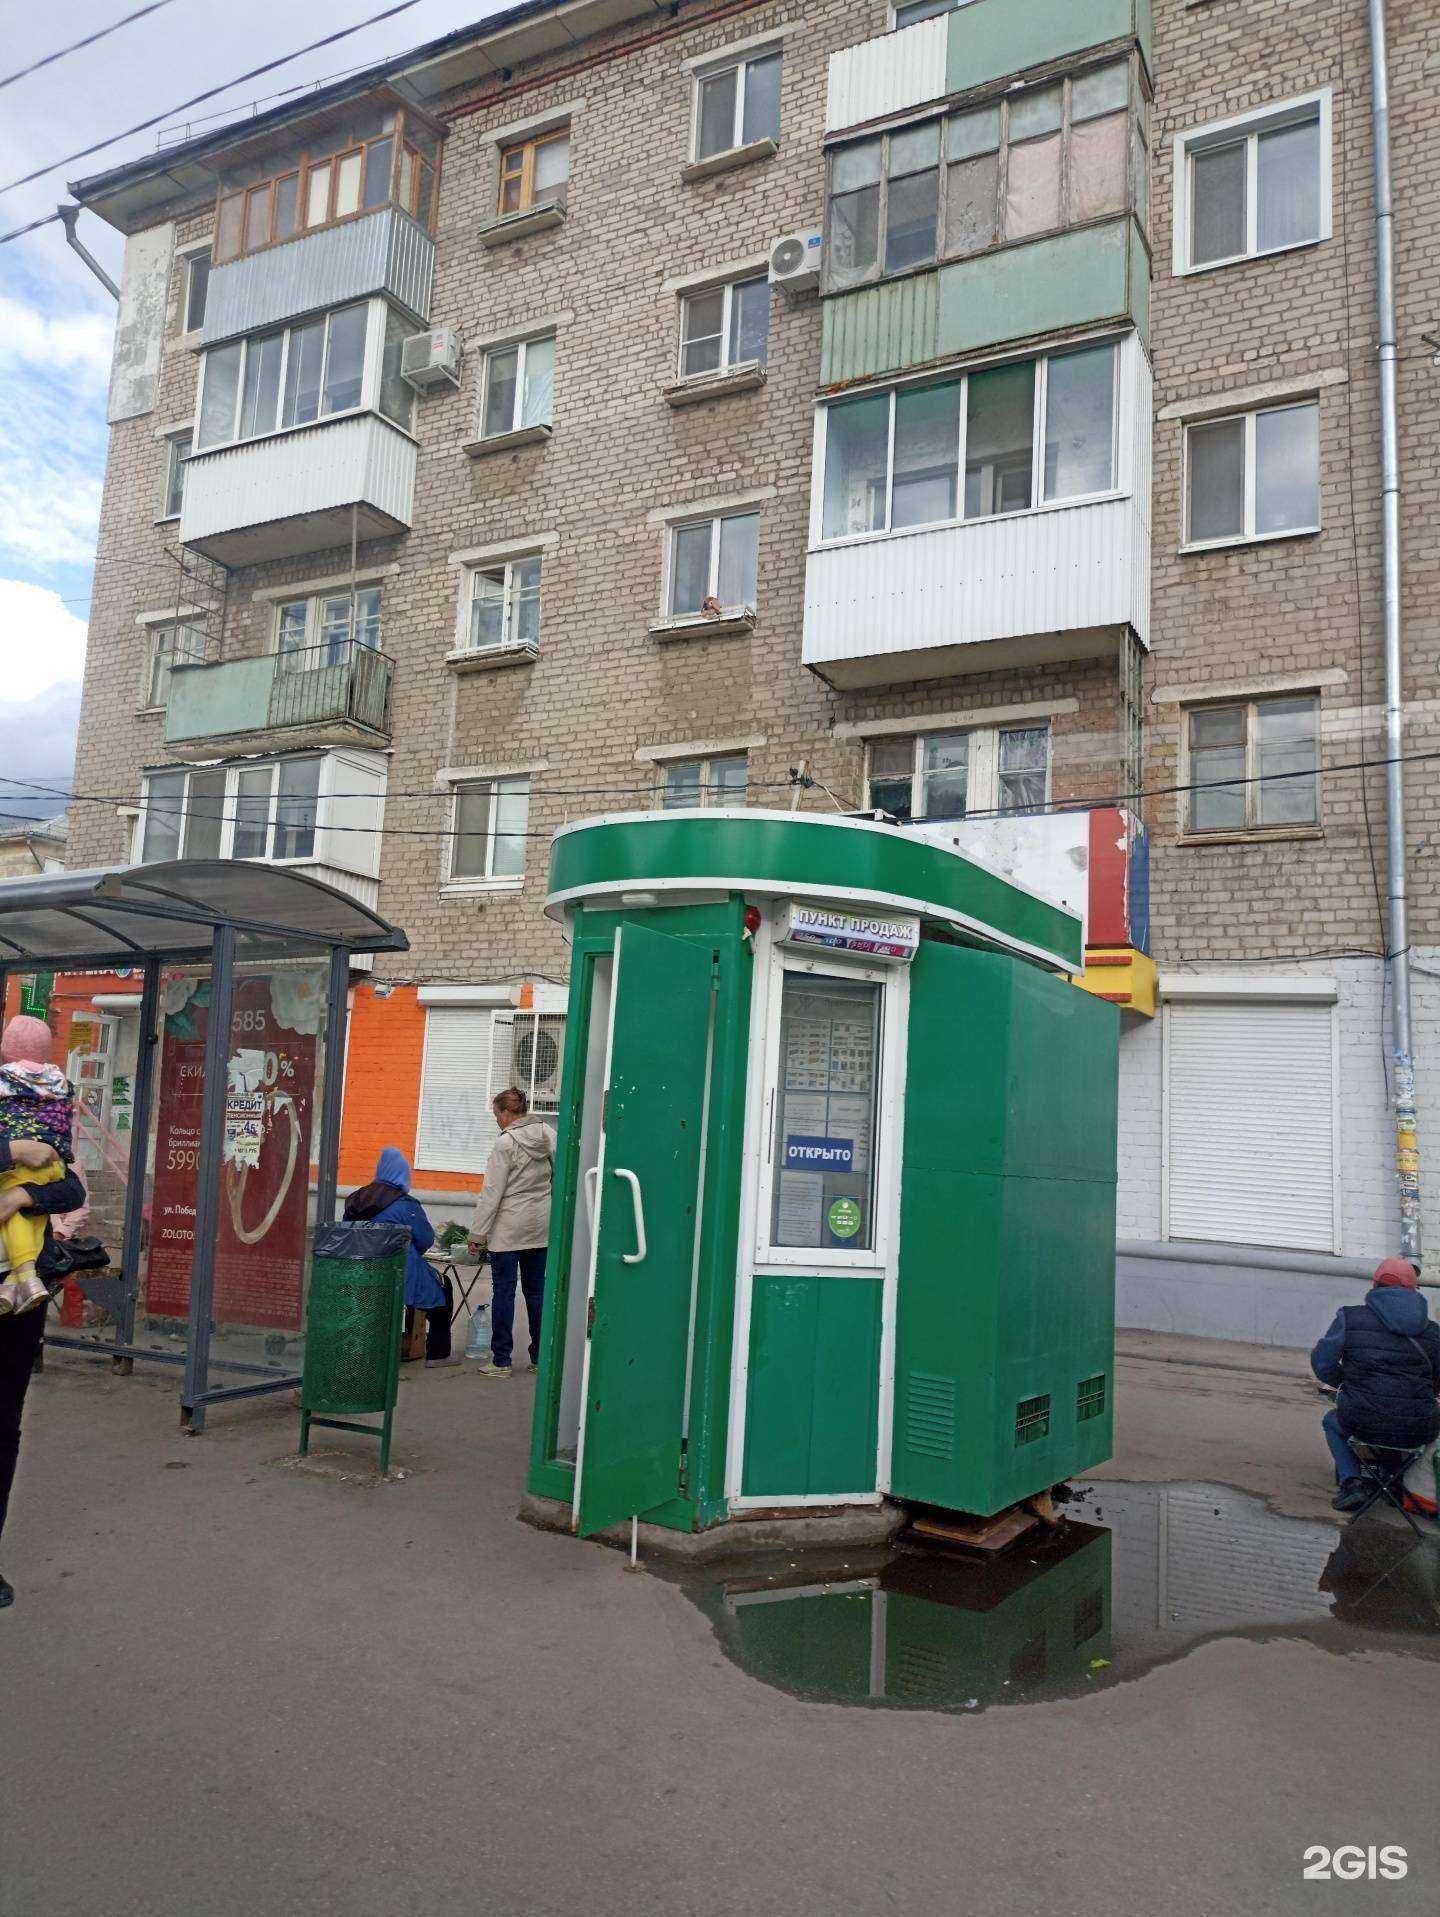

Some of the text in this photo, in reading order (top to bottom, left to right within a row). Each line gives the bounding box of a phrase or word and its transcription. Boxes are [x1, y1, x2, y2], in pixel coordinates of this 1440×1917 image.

[799, 909, 846, 929] ПУНКТ
[849, 915, 913, 940] ПРОДАЖ
[232, 1009, 266, 1032] 585
[227, 1097, 263, 1112] КРЕДИТ
[169, 1125, 195, 1136] Кольцо
[788, 1145, 852, 1161] ОТКРЫТО
